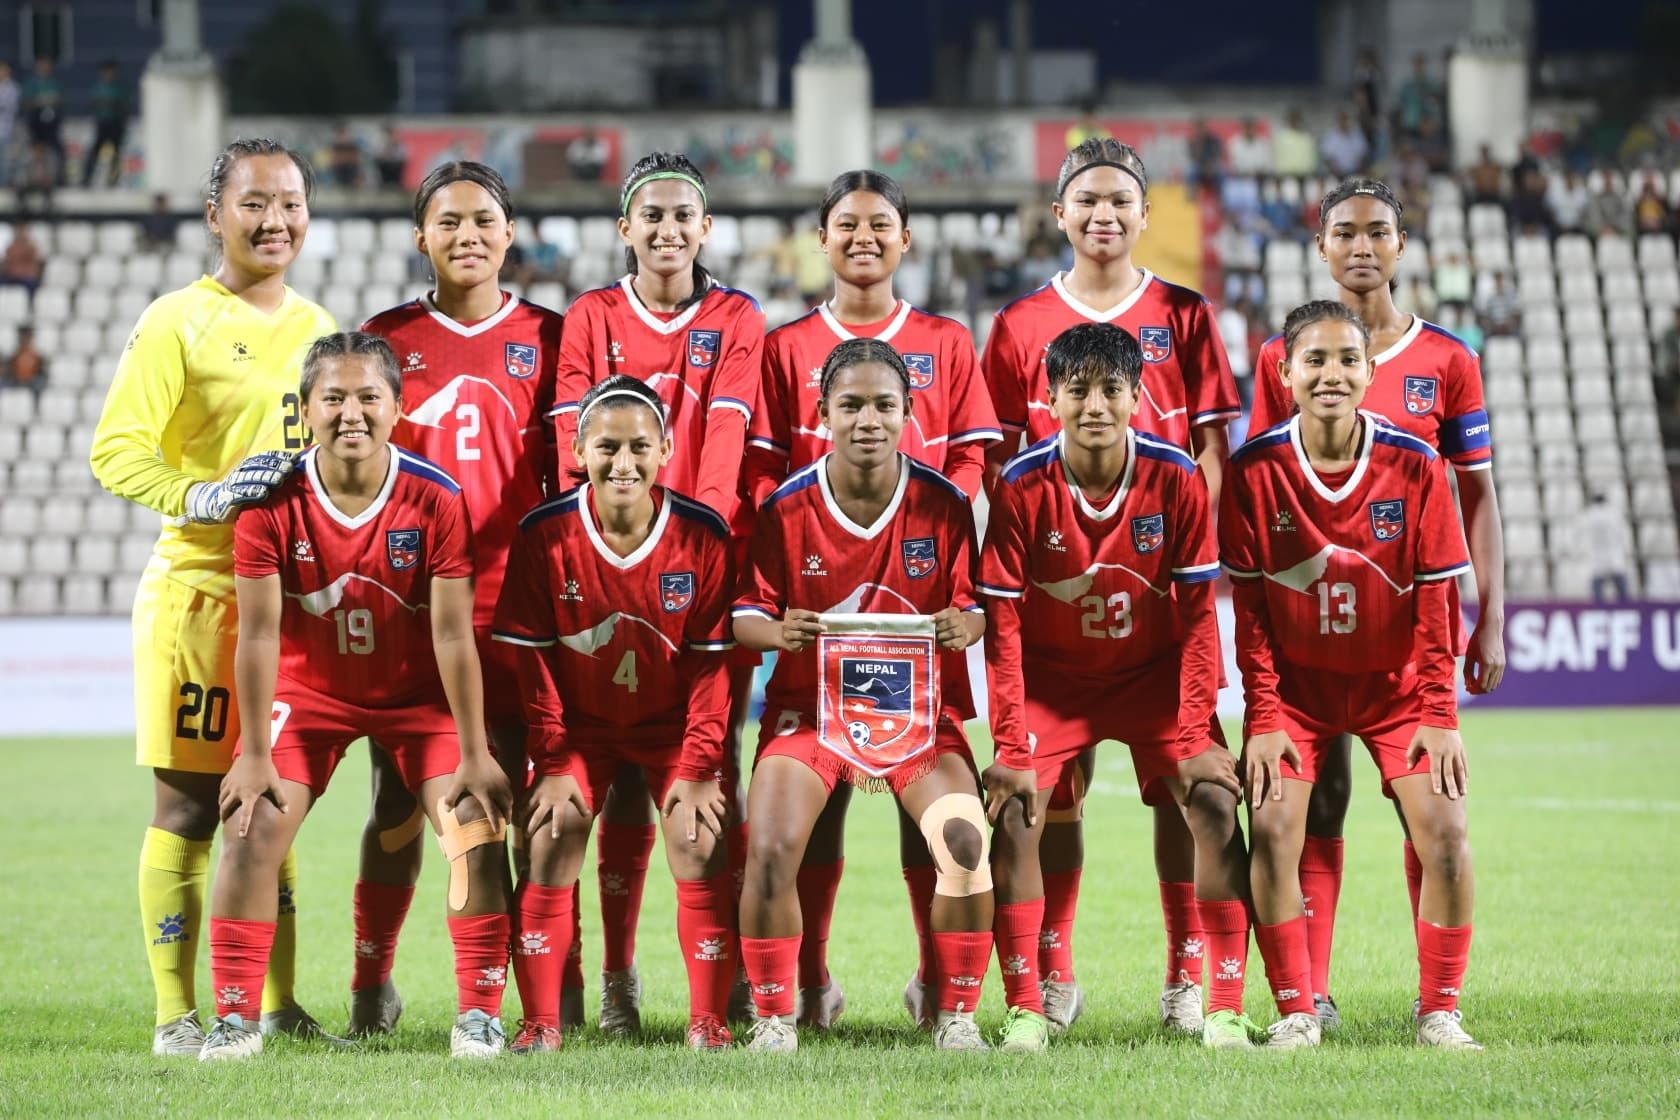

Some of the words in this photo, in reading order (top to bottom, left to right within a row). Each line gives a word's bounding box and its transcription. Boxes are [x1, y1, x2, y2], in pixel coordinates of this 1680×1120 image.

[402, 364, 427, 372] KELME
[456, 403, 481, 461] 2
[560, 594, 584, 602] KELME
[1317, 582, 1357, 635] 13
[1080, 591, 1133, 639] 23
[334, 608, 376, 655] 19
[1507, 608, 1641, 673] SAFF
[841, 645, 859, 653] NEPAL
[860, 645, 887, 654] FOOTBALL
[888, 647, 925, 656] ASSOCIATION
[612, 649, 638, 693] 4
[855, 663, 898, 676] NEPAL
[176, 681, 231, 742] 20
[153, 931, 190, 946] KELME
[516, 947, 551, 956] KELME
[695, 952, 729, 961] KELME
[475, 978, 506, 986] KELM
[950, 977, 981, 987] KELME
[1216, 972, 1243, 981] KELME
[754, 985, 785, 995] KELME
